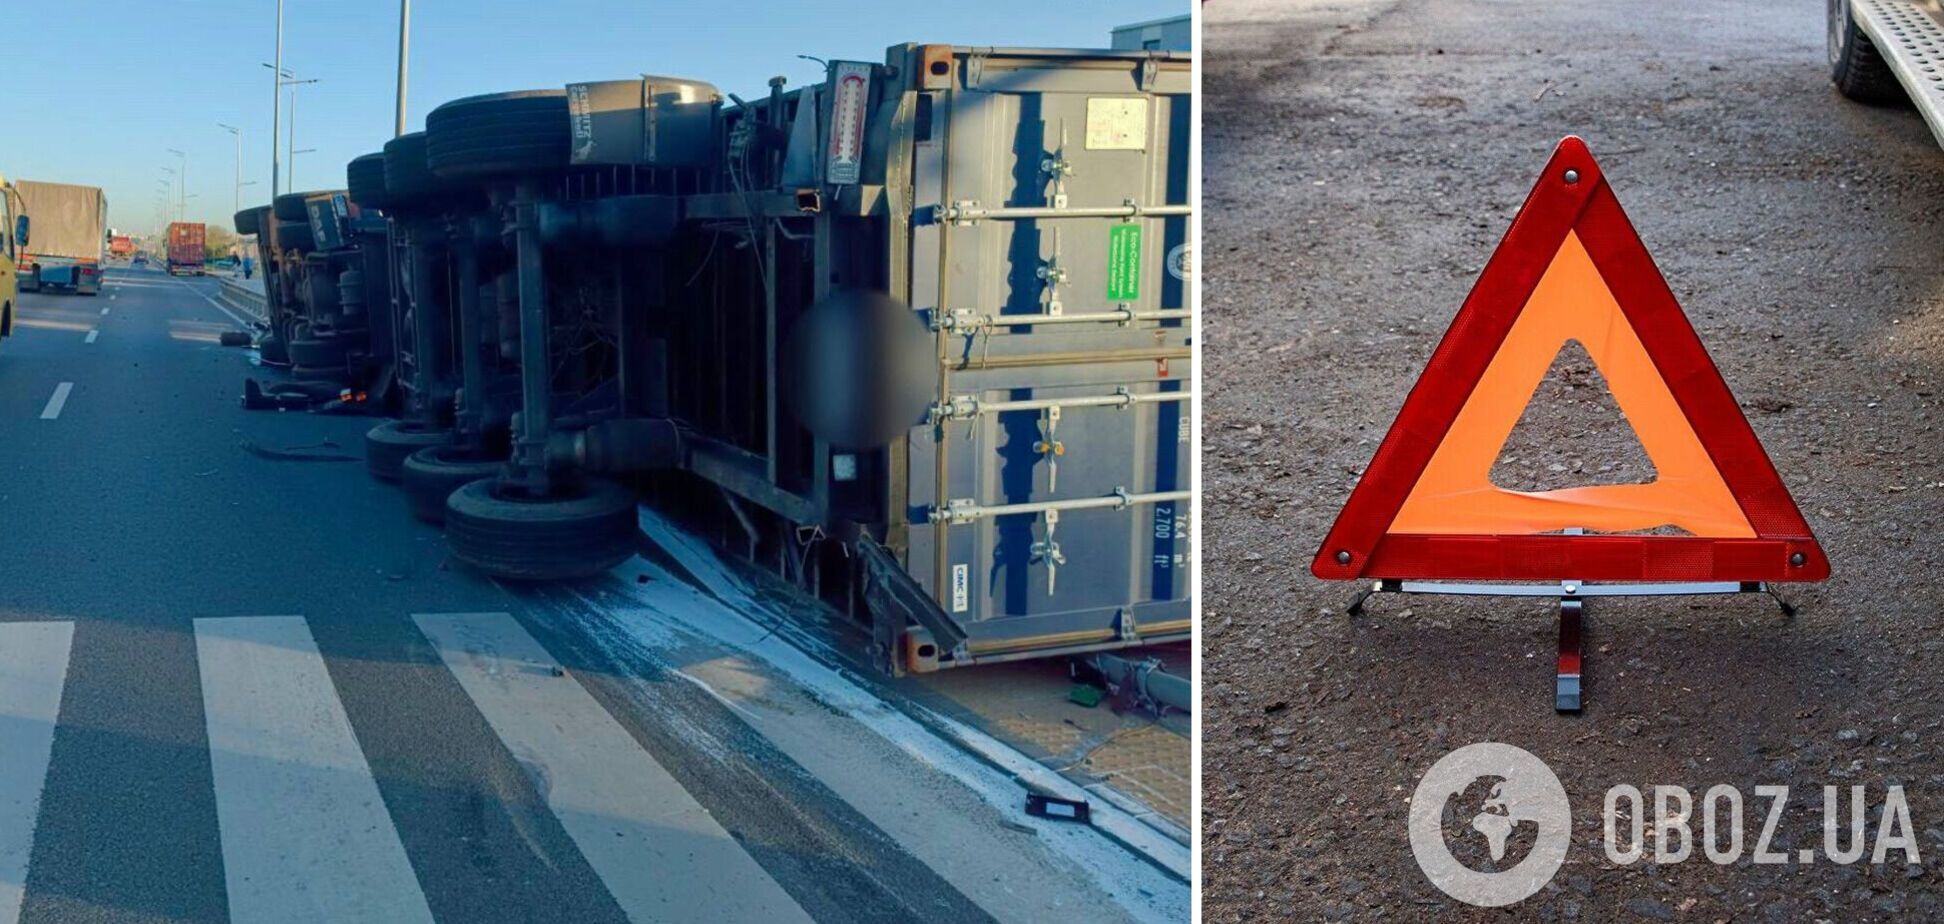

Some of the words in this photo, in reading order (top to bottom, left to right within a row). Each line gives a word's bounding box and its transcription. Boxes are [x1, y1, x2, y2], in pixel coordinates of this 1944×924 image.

[311, 206, 326, 241] DAF
[1178, 416, 1190, 443] CUBE
[1155, 507, 1171, 538] 2.700
[1174, 514, 1187, 539] 76.4
